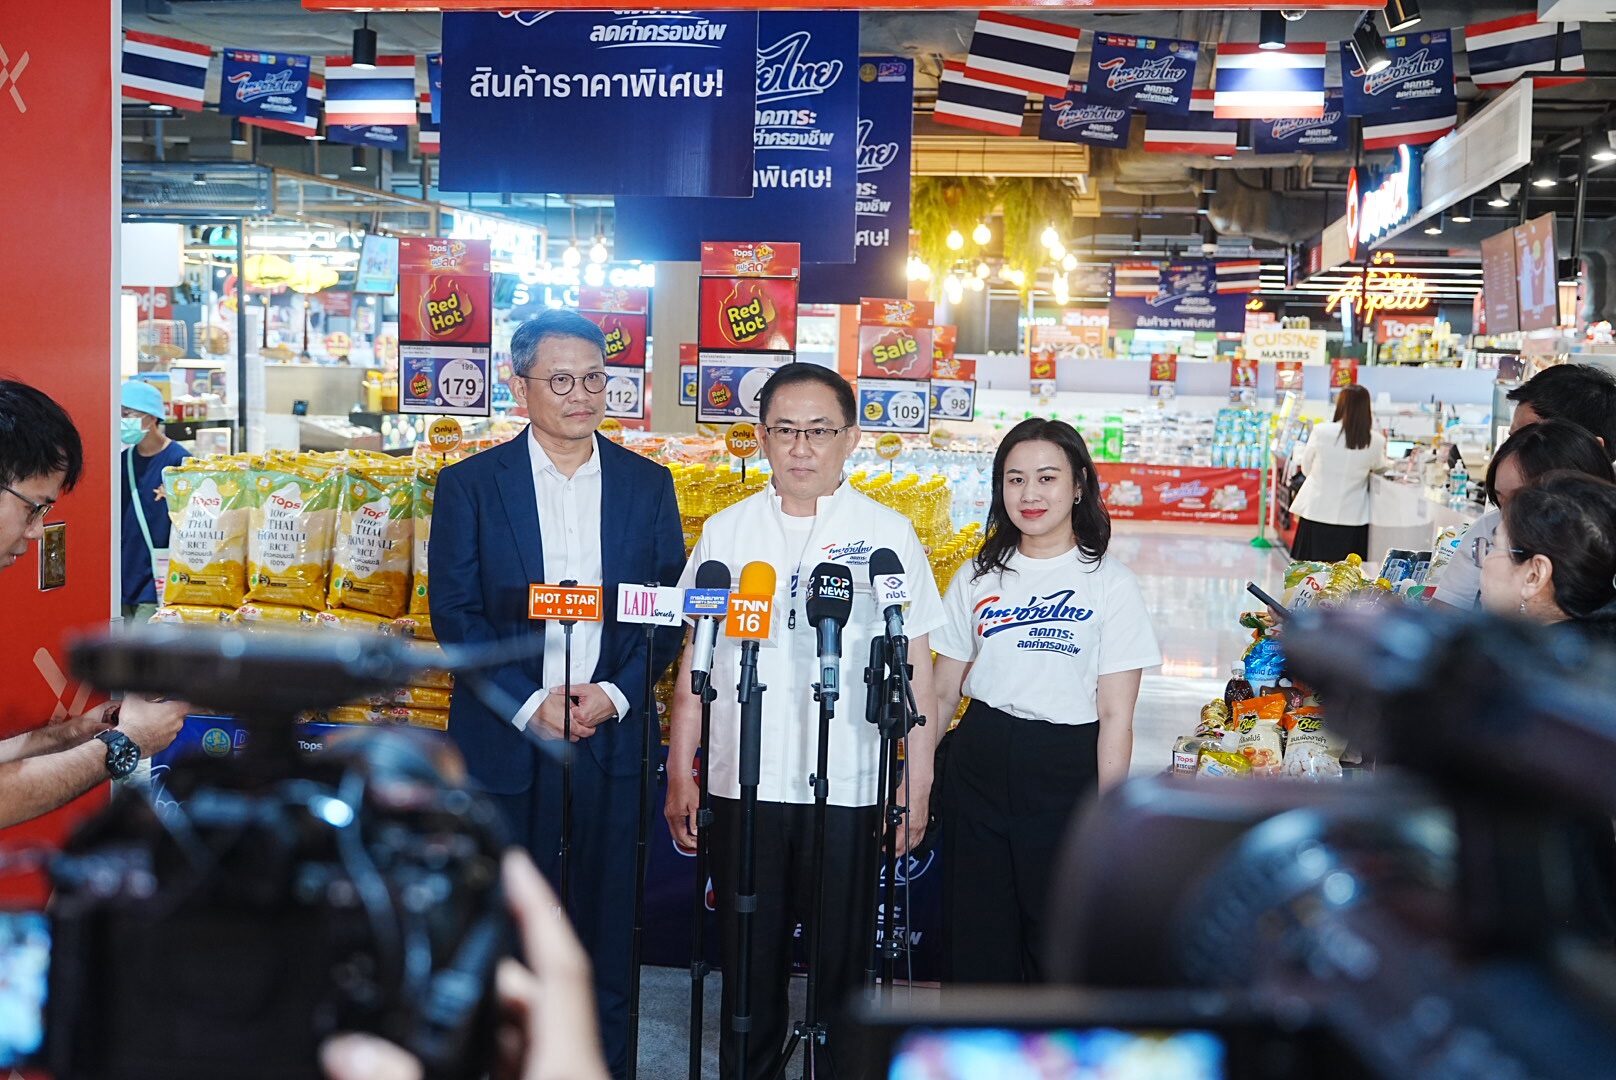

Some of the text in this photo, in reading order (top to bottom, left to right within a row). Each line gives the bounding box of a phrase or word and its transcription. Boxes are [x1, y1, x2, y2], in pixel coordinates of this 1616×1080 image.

[589, 20, 727, 42] ลดค่าครองชีพ
[470, 65, 723, 97] สินค้าราคาพิเศษ!
[428, 244, 447, 253] Tops
[732, 249, 753, 258] Tops
[427, 293, 458, 316] Red
[727, 298, 760, 323] Red
[432, 310, 463, 330] Hot
[732, 315, 766, 338] Hot
[605, 328, 621, 342] ed
[872, 338, 918, 364] Sale
[1260, 350, 1310, 360] MASTERS
[462, 363, 474, 371] 199
[442, 378, 477, 396] 179
[607, 390, 632, 404] 112
[867, 404, 876, 415] 3
[951, 399, 967, 410] 98
[893, 406, 920, 419] 109
[434, 425, 453, 434] Only
[732, 430, 751, 438] Only
[431, 434, 459, 445] Tops
[730, 438, 757, 450] Tops
[192, 496, 220, 507] Tops
[271, 495, 301, 510] Tops
[188, 519, 212, 529] THAI
[268, 519, 295, 531] THAI
[199, 531, 224, 541] MALI
[187, 541, 207, 549] RICE
[269, 542, 290, 552] RICE
[821, 540, 873, 560] ไทยช่วยไทย
[269, 558, 287, 567] 100%
[820, 575, 850, 588] TOP
[819, 586, 850, 598] NEWS
[885, 590, 907, 599] nbt
[534, 593, 596, 605] HOT STAR
[624, 590, 657, 617] LADY
[731, 600, 768, 613] TNN
[972, 589, 1094, 637] ไทยช่วยไทย
[654, 607, 676, 622] Society
[736, 613, 760, 632] 16
[1028, 627, 1075, 640] ลดภาระ
[1016, 638, 1081, 655] ลดค่าครองชีพ
[297, 740, 324, 753] Tops
[1176, 755, 1194, 763] Tops
